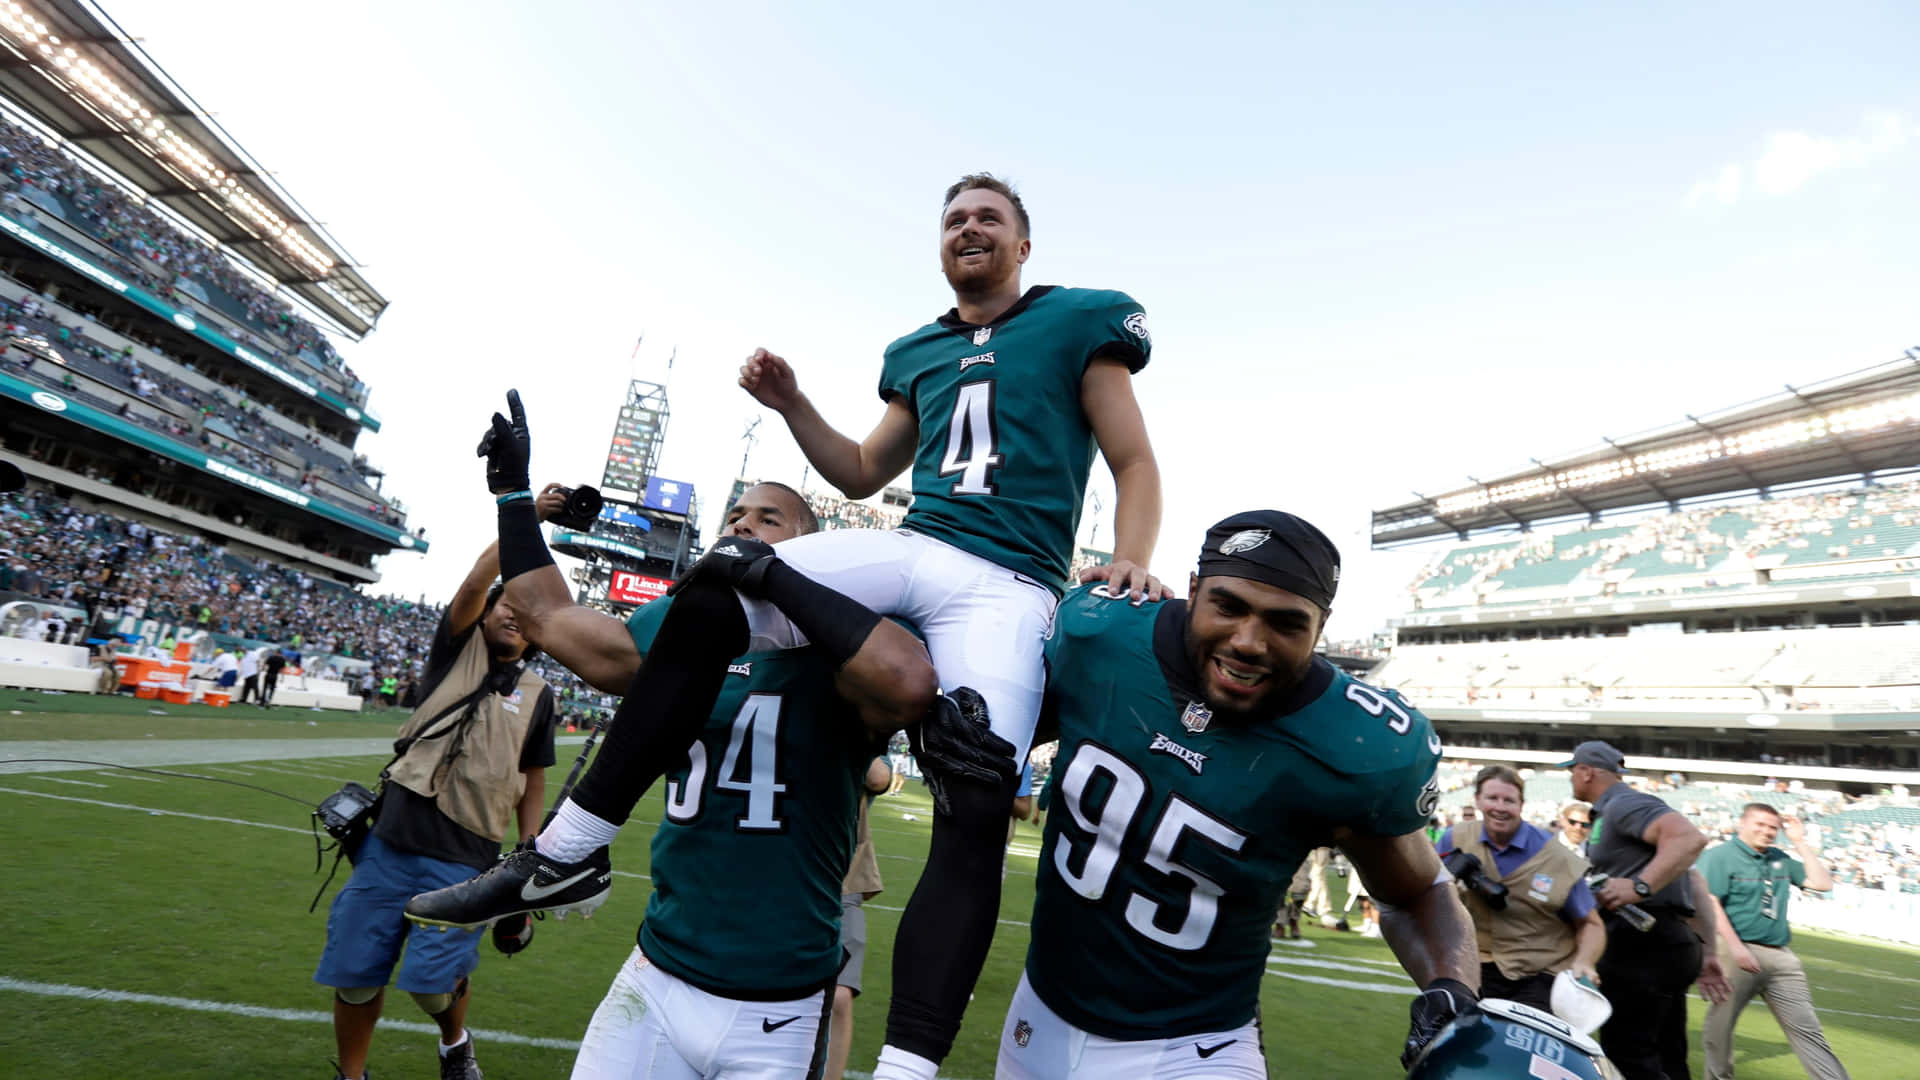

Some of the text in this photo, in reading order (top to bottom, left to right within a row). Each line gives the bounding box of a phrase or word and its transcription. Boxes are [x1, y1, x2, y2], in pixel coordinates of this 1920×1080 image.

[939, 379, 1003, 496] 4
[1149, 732, 1208, 774] EAGLES
[1053, 741, 1248, 952] 95
